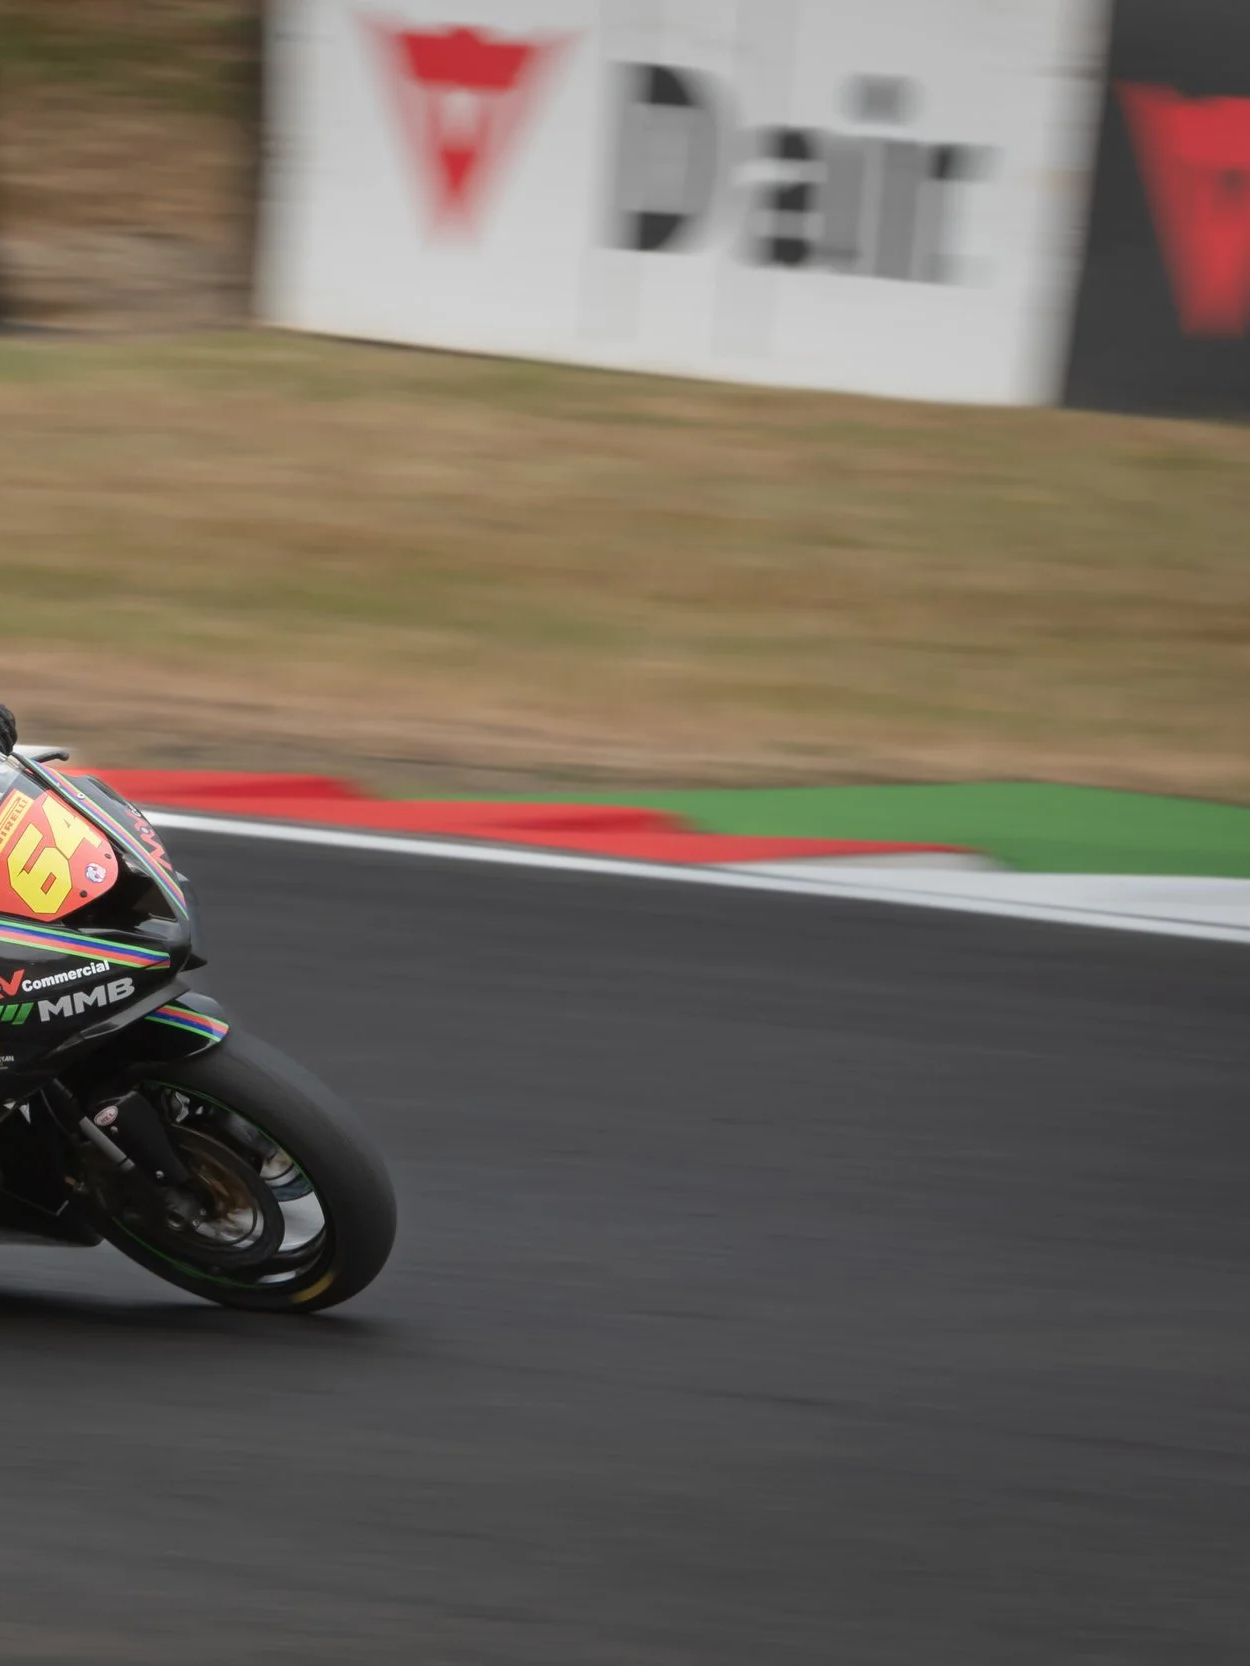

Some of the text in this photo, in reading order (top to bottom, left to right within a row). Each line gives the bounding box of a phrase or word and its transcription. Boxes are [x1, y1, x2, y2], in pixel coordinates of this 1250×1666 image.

[7, 795, 102, 915] 64
[21, 959, 110, 993] Commercial
[38, 977, 136, 1022] MMB
